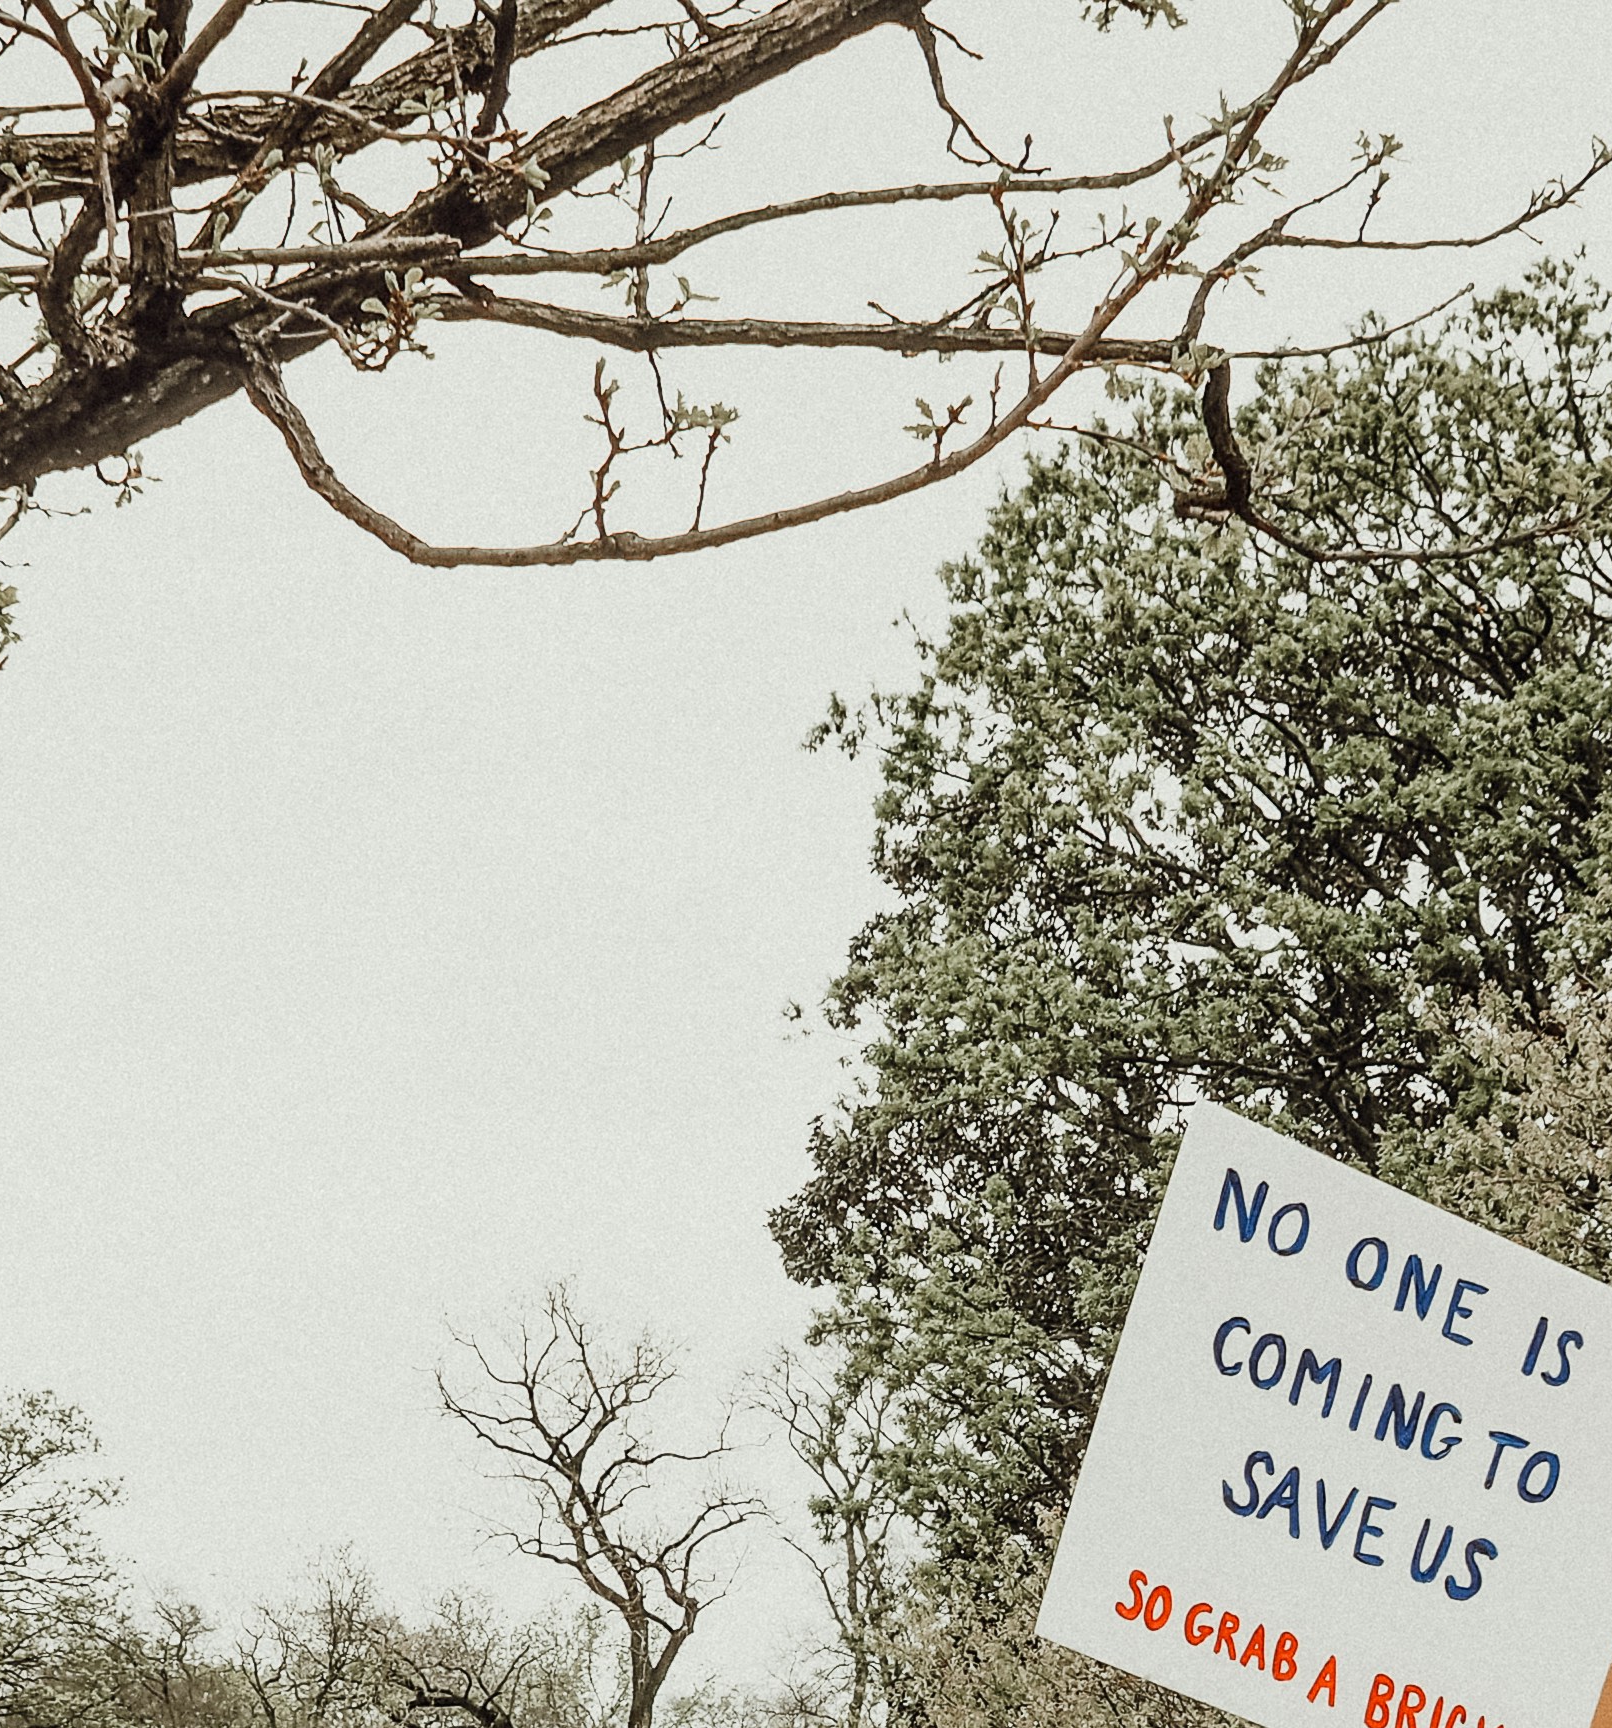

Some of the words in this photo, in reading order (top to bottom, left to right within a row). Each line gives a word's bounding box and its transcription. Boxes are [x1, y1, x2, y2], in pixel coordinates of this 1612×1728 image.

[1213, 1168, 1310, 1257] NO
[1345, 1236, 1490, 1346] ONE
[1521, 1316, 1584, 1388] IS
[1213, 1316, 1463, 1461] COMING
[1487, 1430, 1561, 1504] TO
[1222, 1450, 1397, 1567] SAVE
[1409, 1518, 1498, 1601] US
[1115, 1569, 1173, 1632] SO
[1183, 1602, 1299, 1682] GRAB
[1307, 1654, 1337, 1708] A
